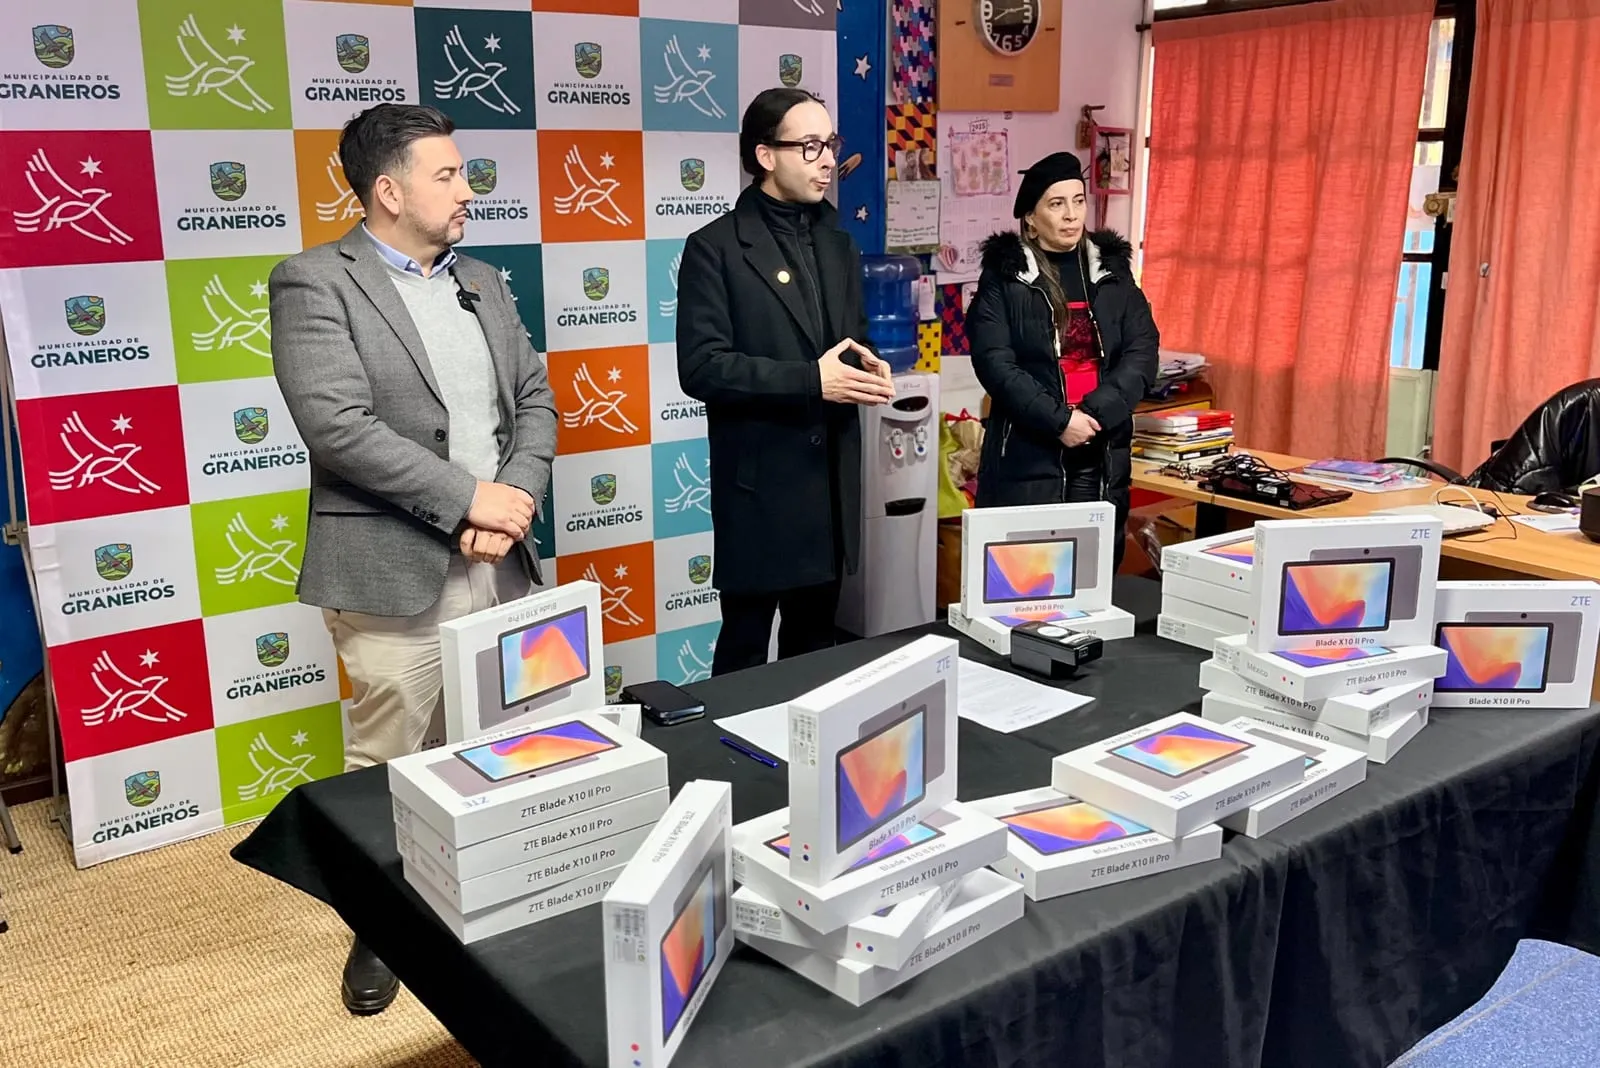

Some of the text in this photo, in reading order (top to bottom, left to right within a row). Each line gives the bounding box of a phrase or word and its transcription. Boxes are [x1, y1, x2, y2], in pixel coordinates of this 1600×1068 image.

[1002, 35, 1012, 52] 6
[1014, 35, 1022, 47] 5
[0, 83, 120, 99] GRANEROS
[304, 86, 406, 102] GRANEROS
[547, 91, 630, 105] GRANEROS
[466, 206, 528, 220] ANEROS
[655, 202, 730, 216] GRANEROS
[176, 214, 286, 231] GRANEROS
[557, 310, 637, 327] GRANEROS
[38, 338, 122, 350] MUNICIPALIDAD
[30, 345, 150, 369] GRANEROS
[661, 406, 706, 420] GRANE
[210, 446, 282, 459] MUNICIPALIDAD
[202, 451, 306, 476] GRANEROS
[572, 506, 626, 518] MUNICIPALIDAD
[1088, 513, 1105, 522] ZTE
[566, 510, 643, 532] GRANEROS
[1411, 528, 1431, 540] ZTE
[68, 581, 148, 598] MUNICIPALIDAD
[61, 584, 175, 615] GRANEROS
[665, 591, 720, 610] GRANER
[1570, 596, 1592, 606] ZTE
[936, 656, 950, 674] ZTE
[233, 666, 303, 684] MUNICIPALIDAD
[1358, 675, 1376, 684] Blade
[1377, 672, 1390, 680] X10
[226, 669, 326, 700] GRANEROS
[1245, 686, 1257, 695] ZTE
[1258, 689, 1280, 700] Blade
[1280, 695, 1296, 706] X10
[1303, 702, 1317, 712] Pro
[1315, 732, 1330, 741] Pro
[521, 786, 611, 818] ZTE Blade X10 II Pro
[1215, 800, 1225, 810] ZTE
[1226, 792, 1243, 805] Blade
[1244, 786, 1256, 796] X10
[1261, 780, 1271, 789] Pro
[100, 799, 190, 828] MUNICIPALIDAD DE
[1290, 800, 1299, 811] ZTE
[92, 805, 200, 844] GRANEROS
[868, 832, 886, 850] Blade
[906, 815, 916, 825] Pro
[524, 819, 612, 851] ZTE Blade X10 II Pro
[527, 850, 615, 883] ZTE Blade X10 II Pro
[1091, 854, 1170, 878] ZTE Blade X10 II Pro
[880, 860, 958, 898] ZTE Blade X10 II Pro
[529, 901, 544, 913] ZTE
[547, 893, 573, 907] Blade
[576, 886, 593, 898] X10
[602, 880, 614, 889] Pr
[910, 923, 981, 967] ZTE Blade X10 II Pro
